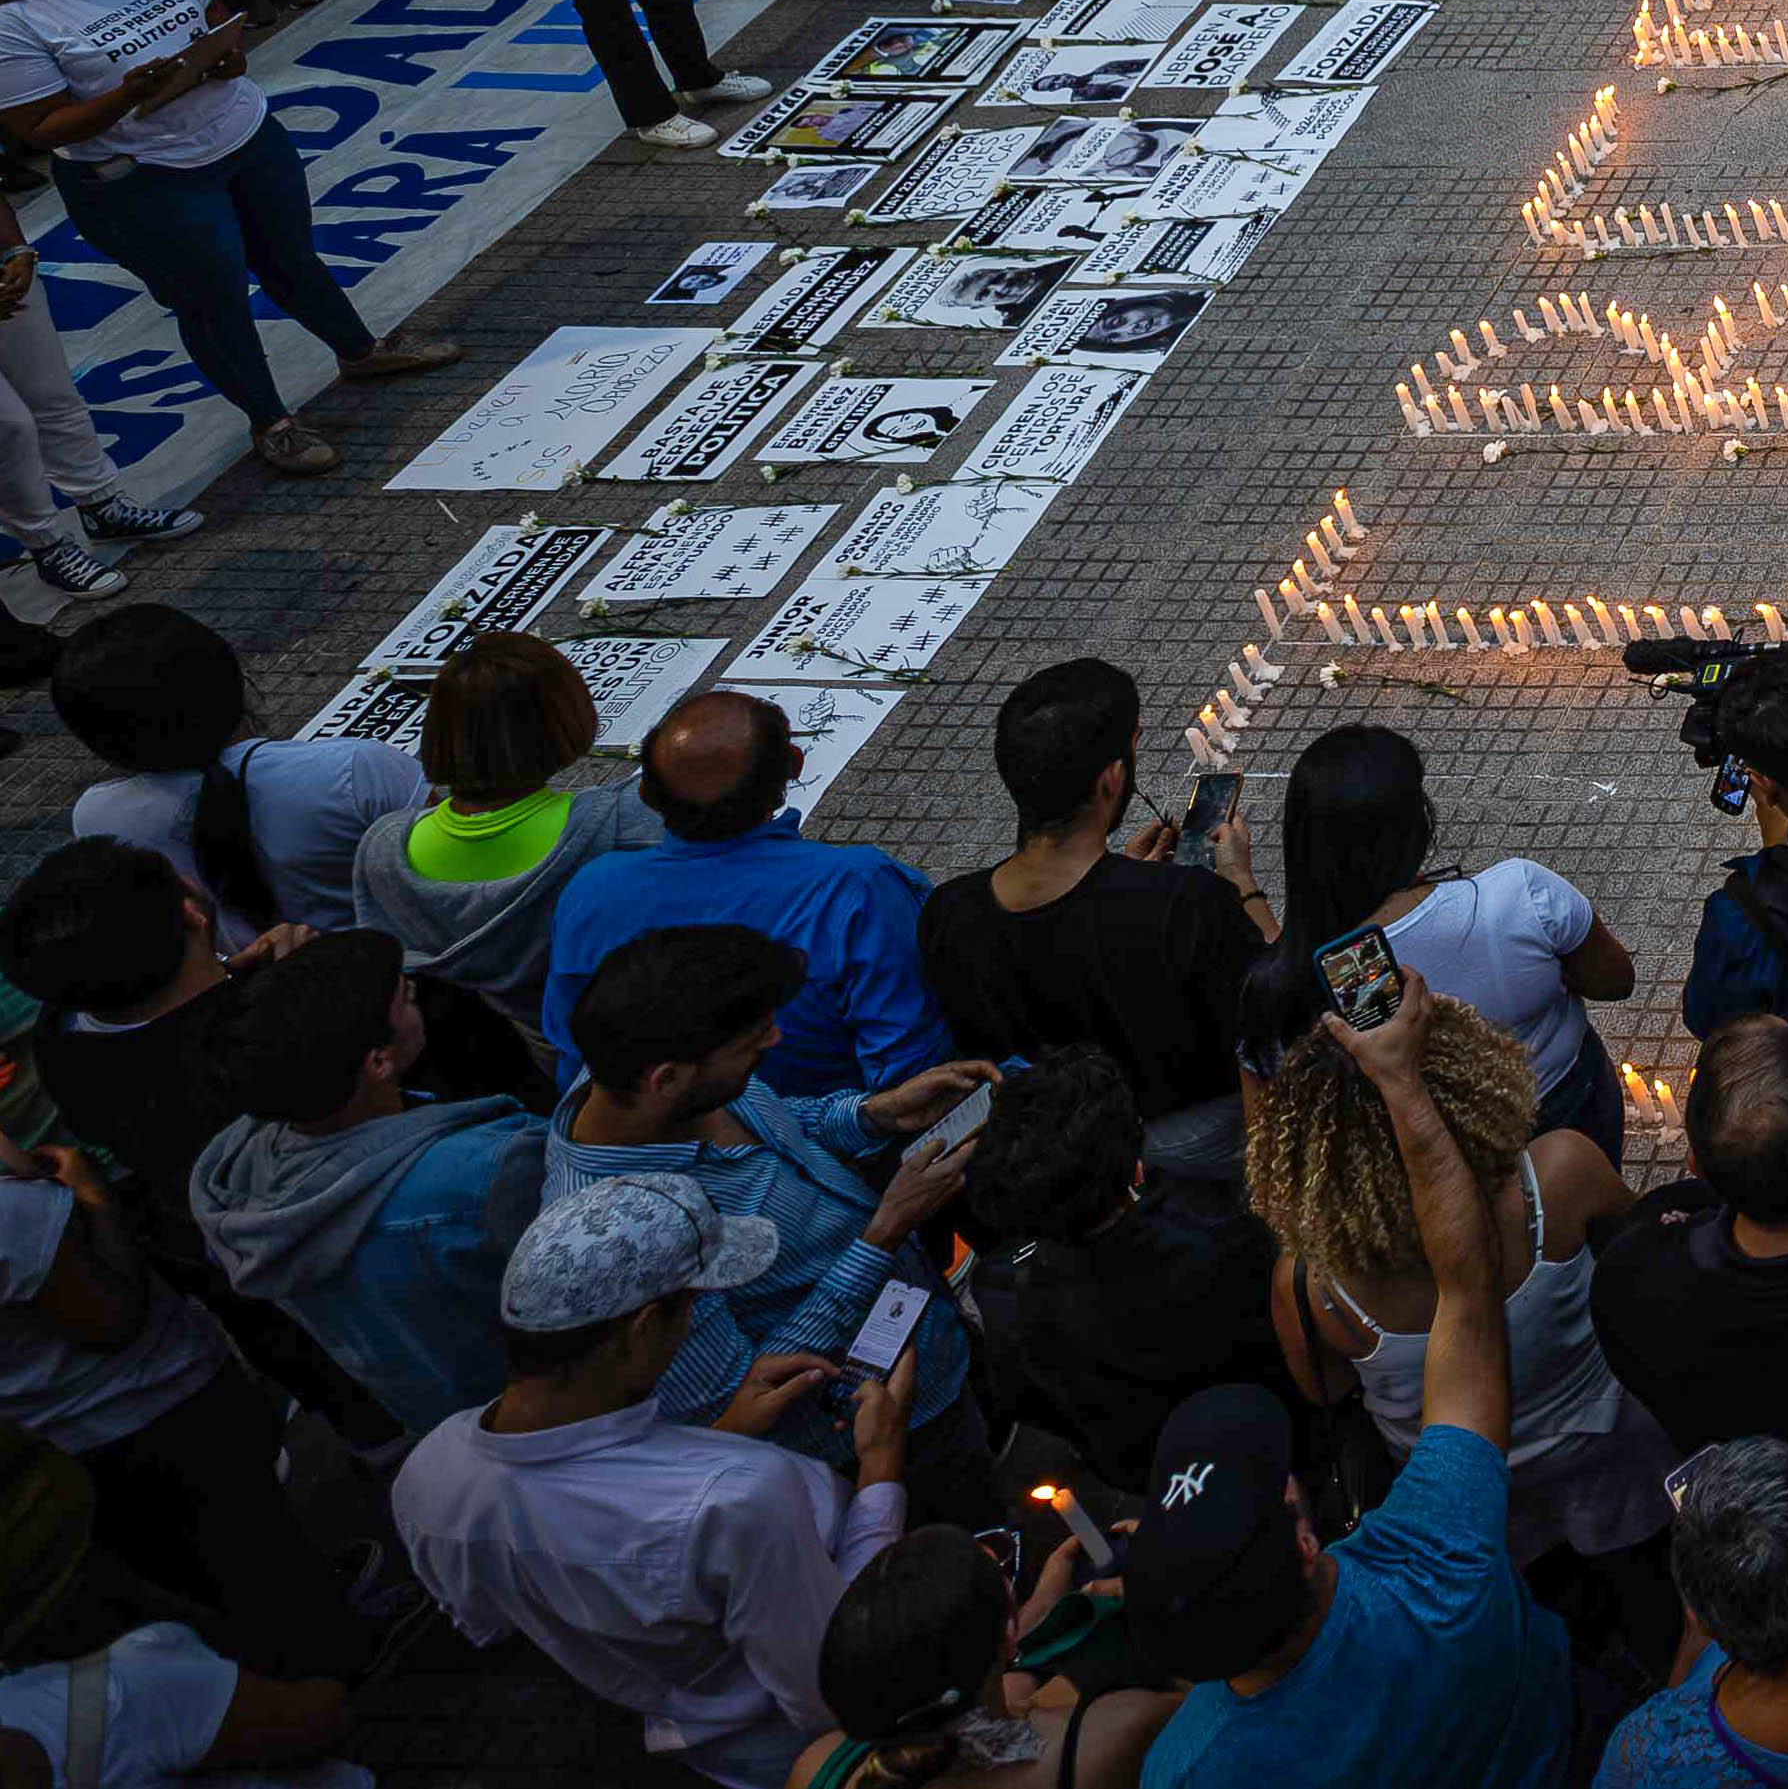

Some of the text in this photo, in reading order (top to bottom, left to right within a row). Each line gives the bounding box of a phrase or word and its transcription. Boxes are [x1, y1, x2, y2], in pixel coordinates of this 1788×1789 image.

[80, 11, 125, 38] LIBEREN
[91, 25, 127, 48] LOS
[106, 5, 200, 63] POLÍTICOS
[814, 22, 884, 78] LIBERTAD
[1156, 8, 1239, 85] LIBEREN A
[1210, 7, 1290, 85] BARRENO
[1305, 3, 1390, 79] FORZADA
[1181, 31, 1247, 85] JOSÉ
[730, 88, 808, 151] LIBERTAD
[903, 135, 979, 215] PRESAS POR
[922, 135, 1000, 212] RAZONES
[946, 132, 1026, 212] POLÍTICAS
[1153, 163, 1189, 200] JAVIER
[1158, 153, 1211, 210] TARAZONA
[1084, 223, 1135, 272] NICOLÁS
[1100, 223, 1150, 273] MADURO
[732, 288, 802, 351] LIBERTAD
[801, 251, 846, 285] PARA
[782, 269, 850, 329] DIGNORA
[869, 278, 910, 321] LIRTAD
[892, 260, 942, 311] LEJANDRO
[904, 260, 960, 317] ONZÁLEZ
[1010, 322, 1044, 356] ROCÍO
[1029, 299, 1086, 355] MIGUEL
[1062, 302, 1108, 350] MADURO
[642, 379, 731, 460] BASTA DE
[650, 363, 765, 477] PERSECUCIÓN
[683, 371, 789, 468] POLÍTICA
[983, 371, 1067, 469] CIERREN LOS
[1002, 372, 1087, 467] CENTROS DE
[1027, 383, 1098, 455] TORTURA
[659, 514, 734, 590] TORTURADO
[674, 513, 717, 552] SIENDO
[835, 500, 894, 562] OSWALDO
[852, 503, 906, 561] CASTILLO
[496, 561, 551, 616] CRIMEN
[547, 535, 571, 558] DE
[506, 534, 590, 623] HUMANIDAD
[747, 595, 815, 659] JUNIOR
[775, 602, 828, 654] SILVA
[593, 641, 657, 702] ES UN
[312, 679, 387, 740] TURA
